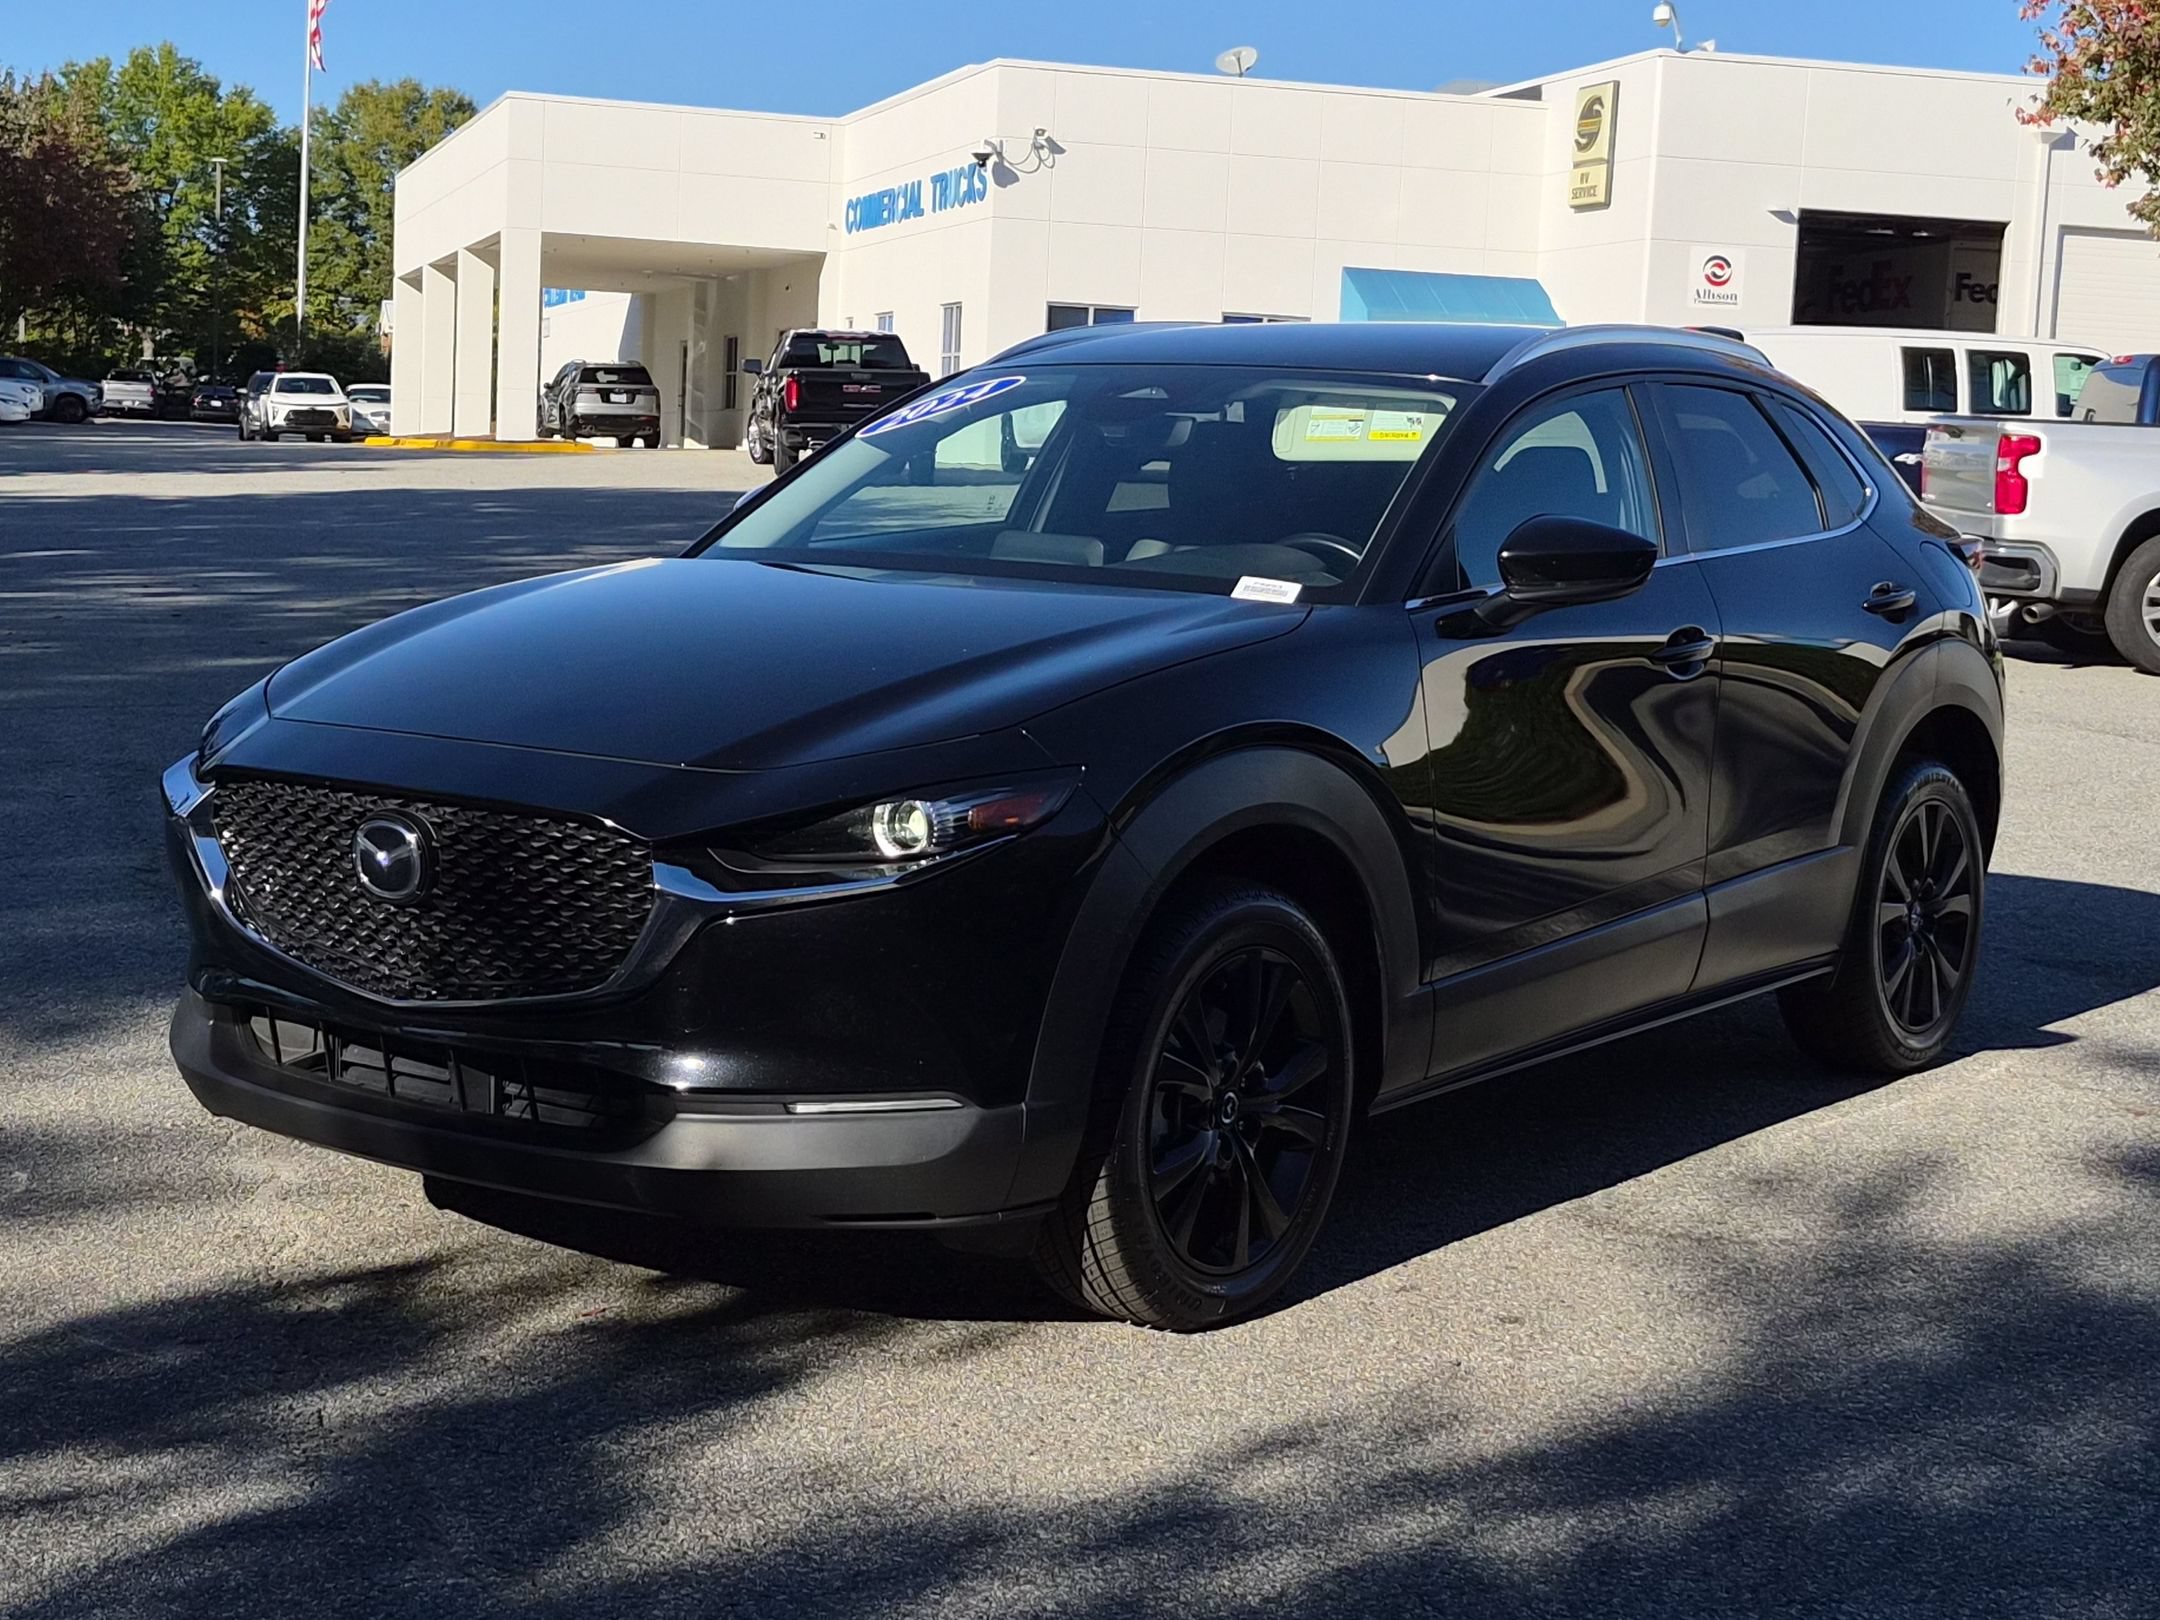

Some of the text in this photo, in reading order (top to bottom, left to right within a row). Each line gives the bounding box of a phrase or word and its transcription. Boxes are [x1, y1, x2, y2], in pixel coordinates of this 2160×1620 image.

[845, 161, 988, 234] COMMERCIAL TRUCKS
[1571, 185, 1598, 200] SERVICE
[1695, 288, 1738, 301] Allison
[1825, 259, 1912, 314] FedEx
